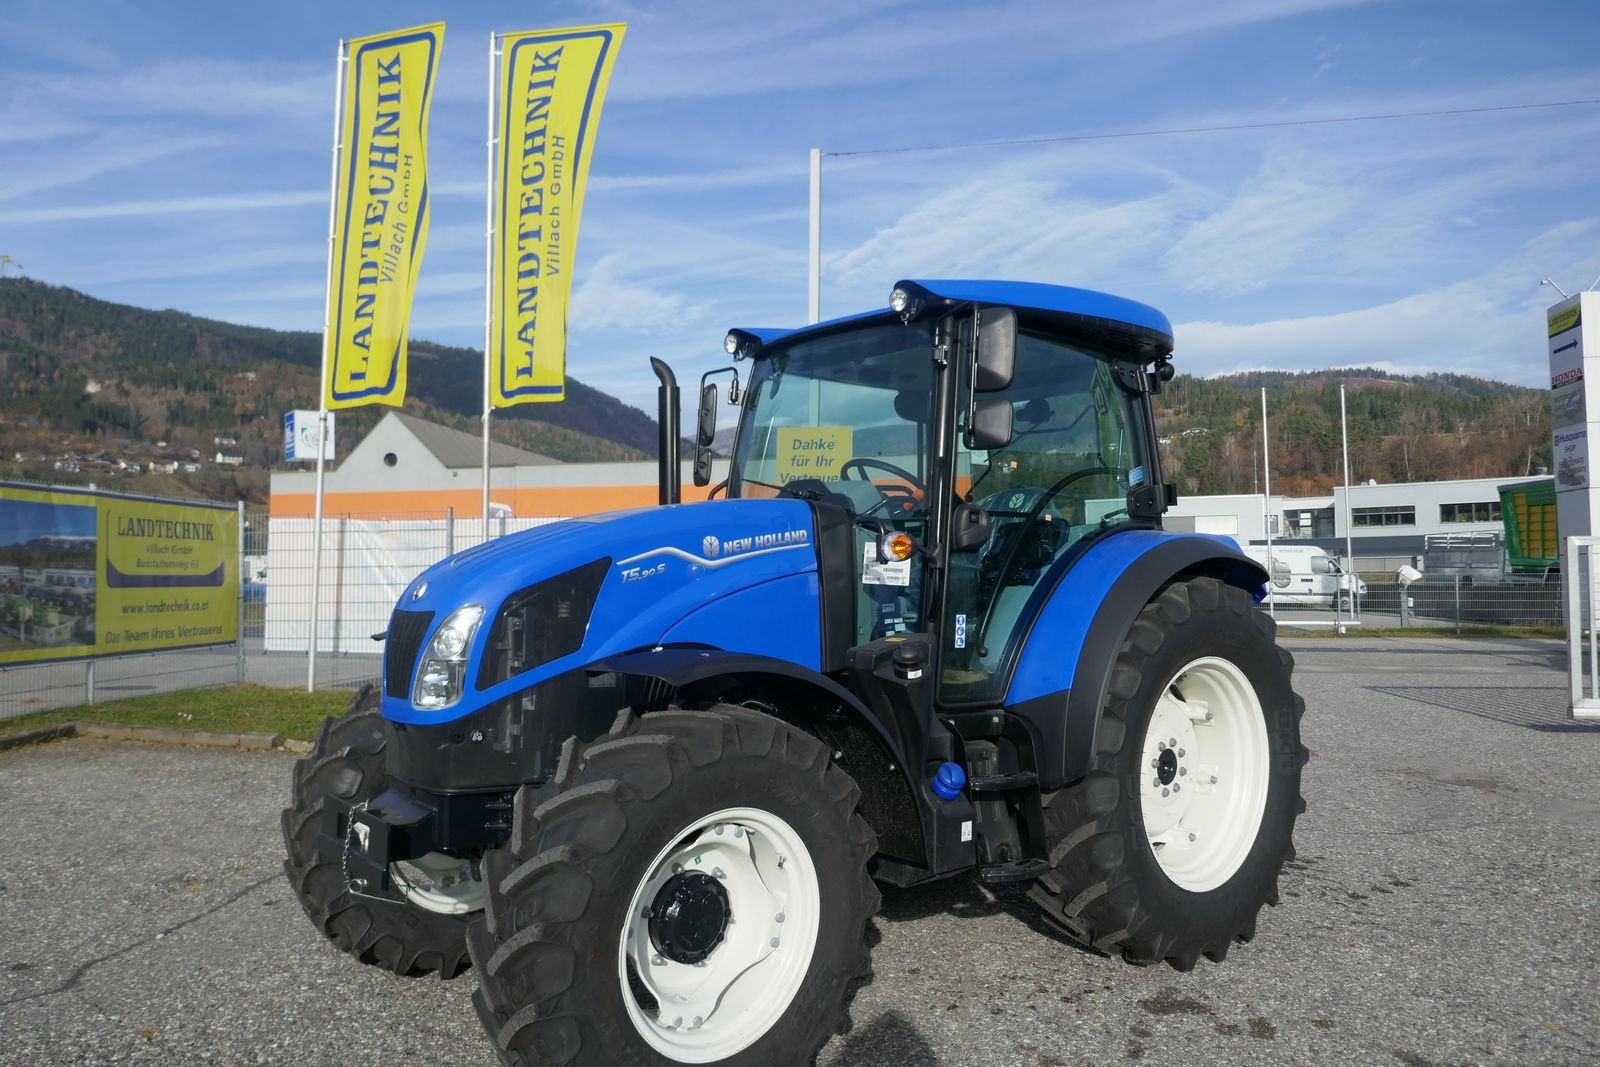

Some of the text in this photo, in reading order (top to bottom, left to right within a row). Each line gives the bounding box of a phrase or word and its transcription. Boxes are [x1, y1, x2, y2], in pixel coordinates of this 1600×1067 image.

[516, 45, 564, 381] LANDTECHNIK
[546, 135, 565, 277] Villach GmbH
[350, 51, 401, 384] LANDTECHNIK
[380, 154, 413, 283] Villach GmbH
[1552, 367, 1583, 385] HONDA
[1559, 430, 1586, 442] Husqvarna
[791, 454, 834, 468] für Ihr
[118, 515, 214, 541] LANDTECHNIK
[146, 544, 194, 554] Villach GmbH
[723, 529, 808, 553] NEW HOLLAND
[121, 599, 209, 614] www.landtechnik.co.at
[105, 624, 223, 644] Das Team Ihres Vertrauens
